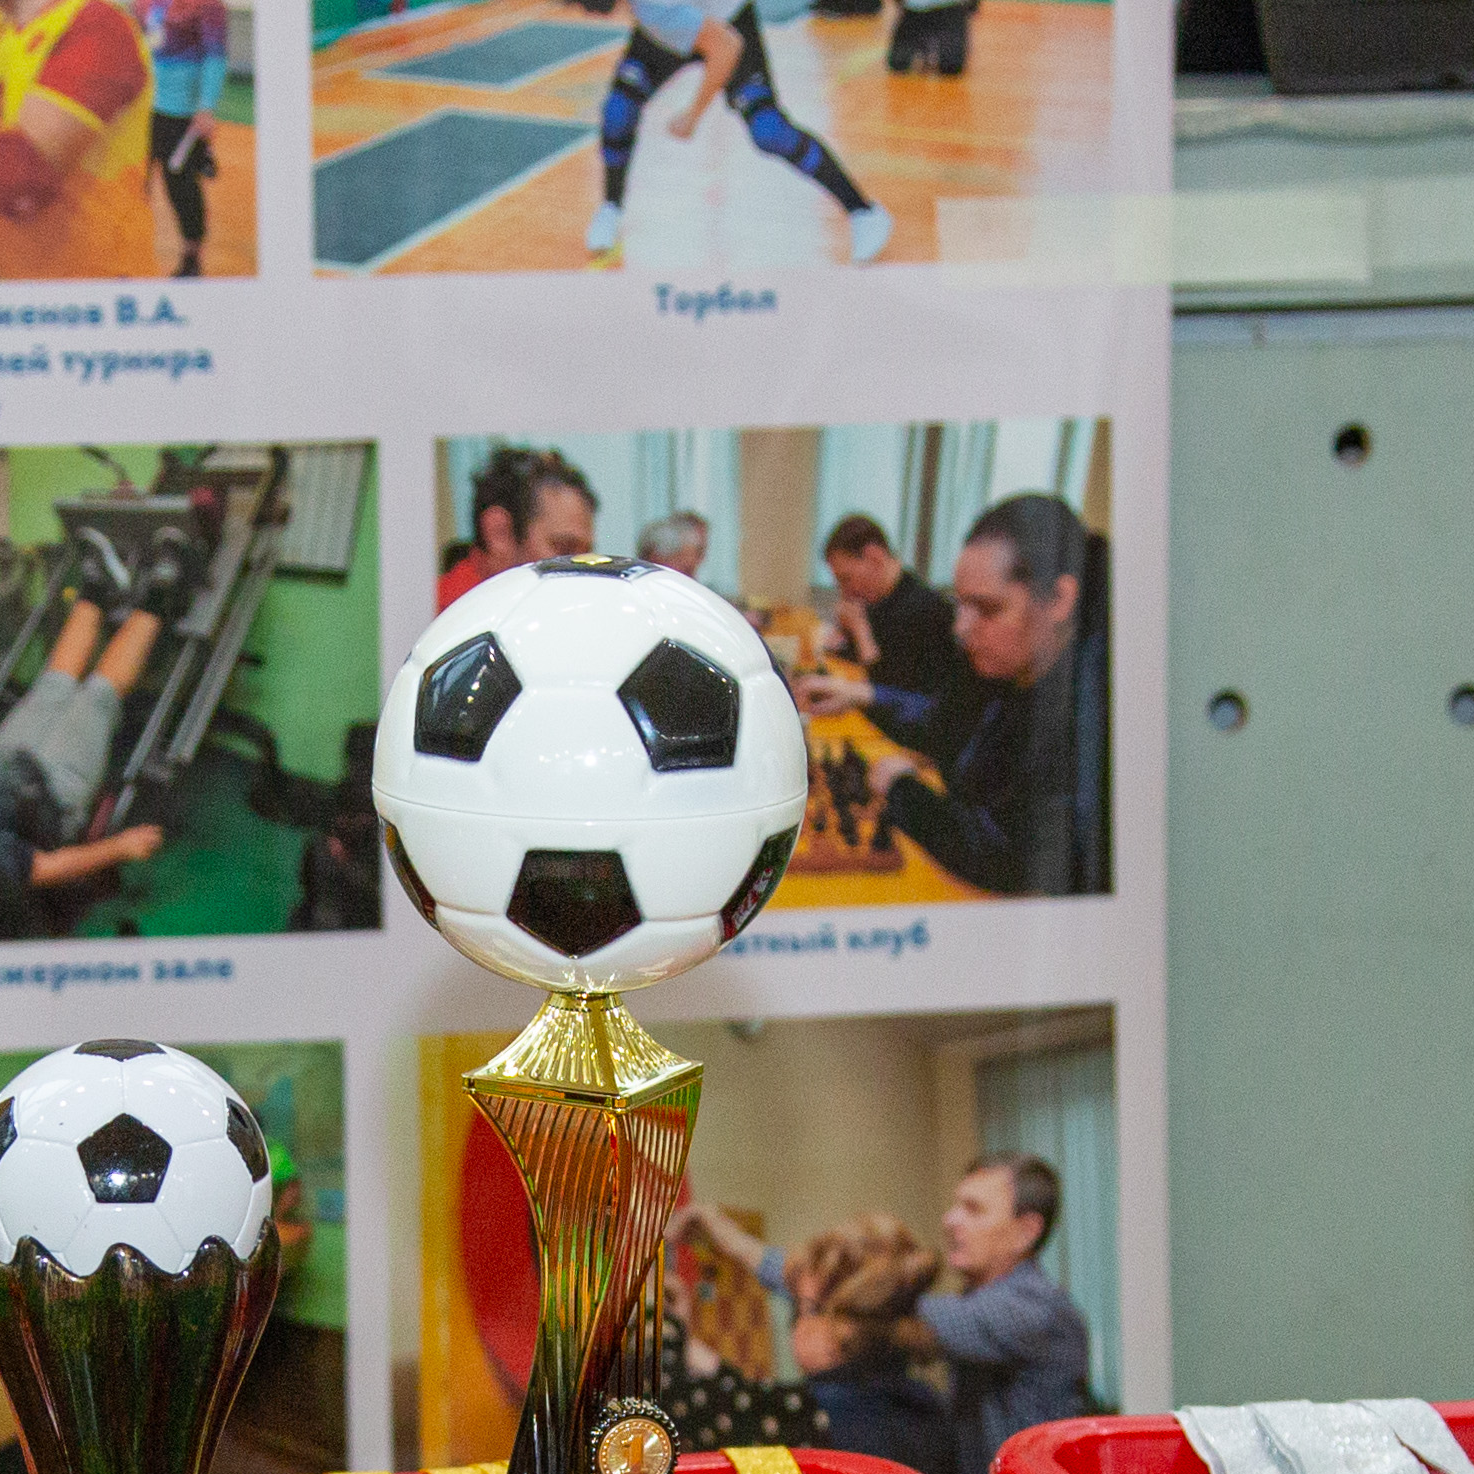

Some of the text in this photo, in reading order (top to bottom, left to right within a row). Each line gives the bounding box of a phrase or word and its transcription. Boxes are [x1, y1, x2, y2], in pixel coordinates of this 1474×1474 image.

[115, 295, 188, 328] В.А.
[653, 281, 778, 325] Торбол
[63, 348, 213, 385] турнира
[847, 916, 930, 959] клуб
[154, 957, 235, 984] зале
